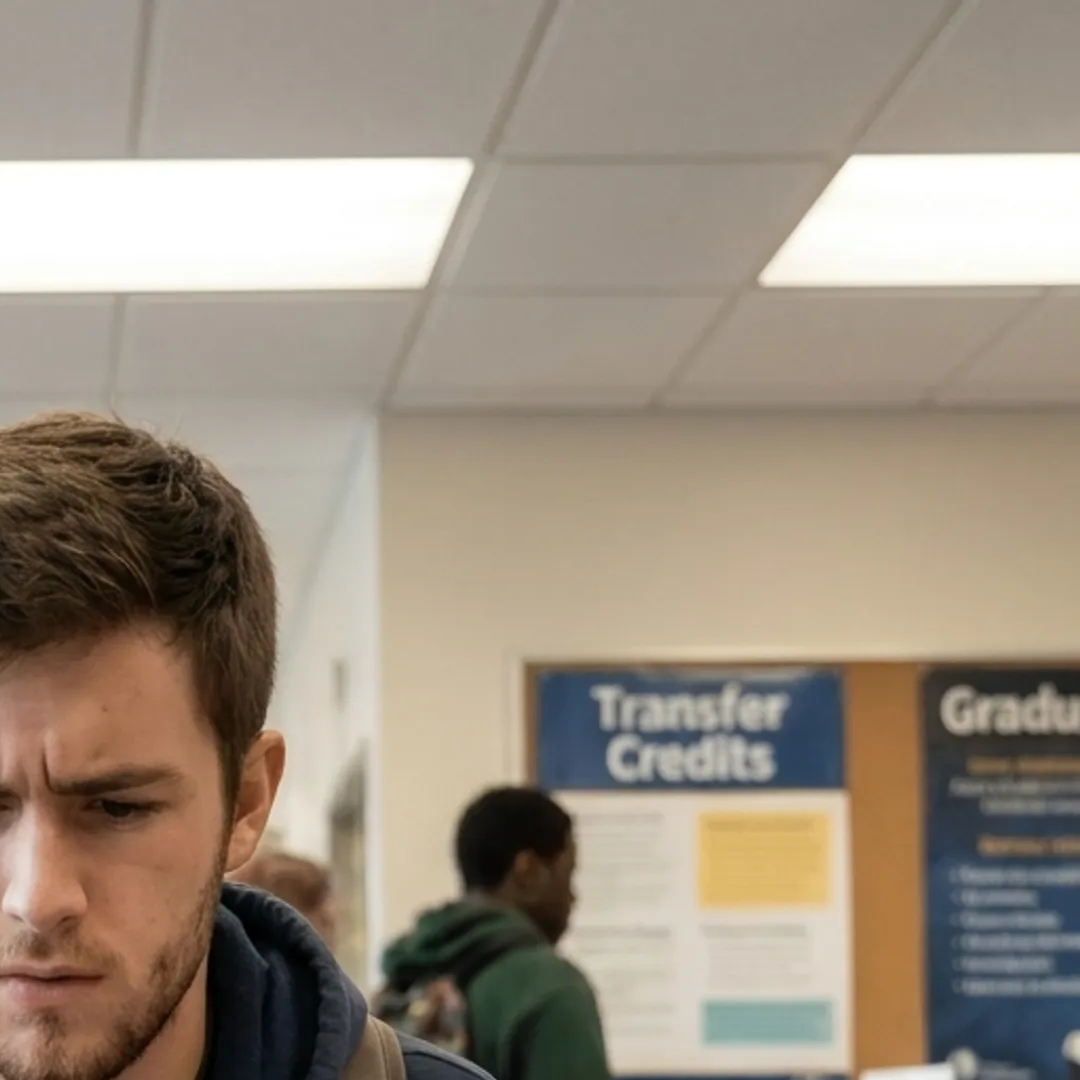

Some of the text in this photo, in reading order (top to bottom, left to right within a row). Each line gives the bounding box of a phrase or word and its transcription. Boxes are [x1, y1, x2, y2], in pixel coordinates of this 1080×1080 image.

[592, 682, 788, 733] Transfer
[940, 682, 1080, 736] Gradu
[606, 733, 776, 782] Credits
